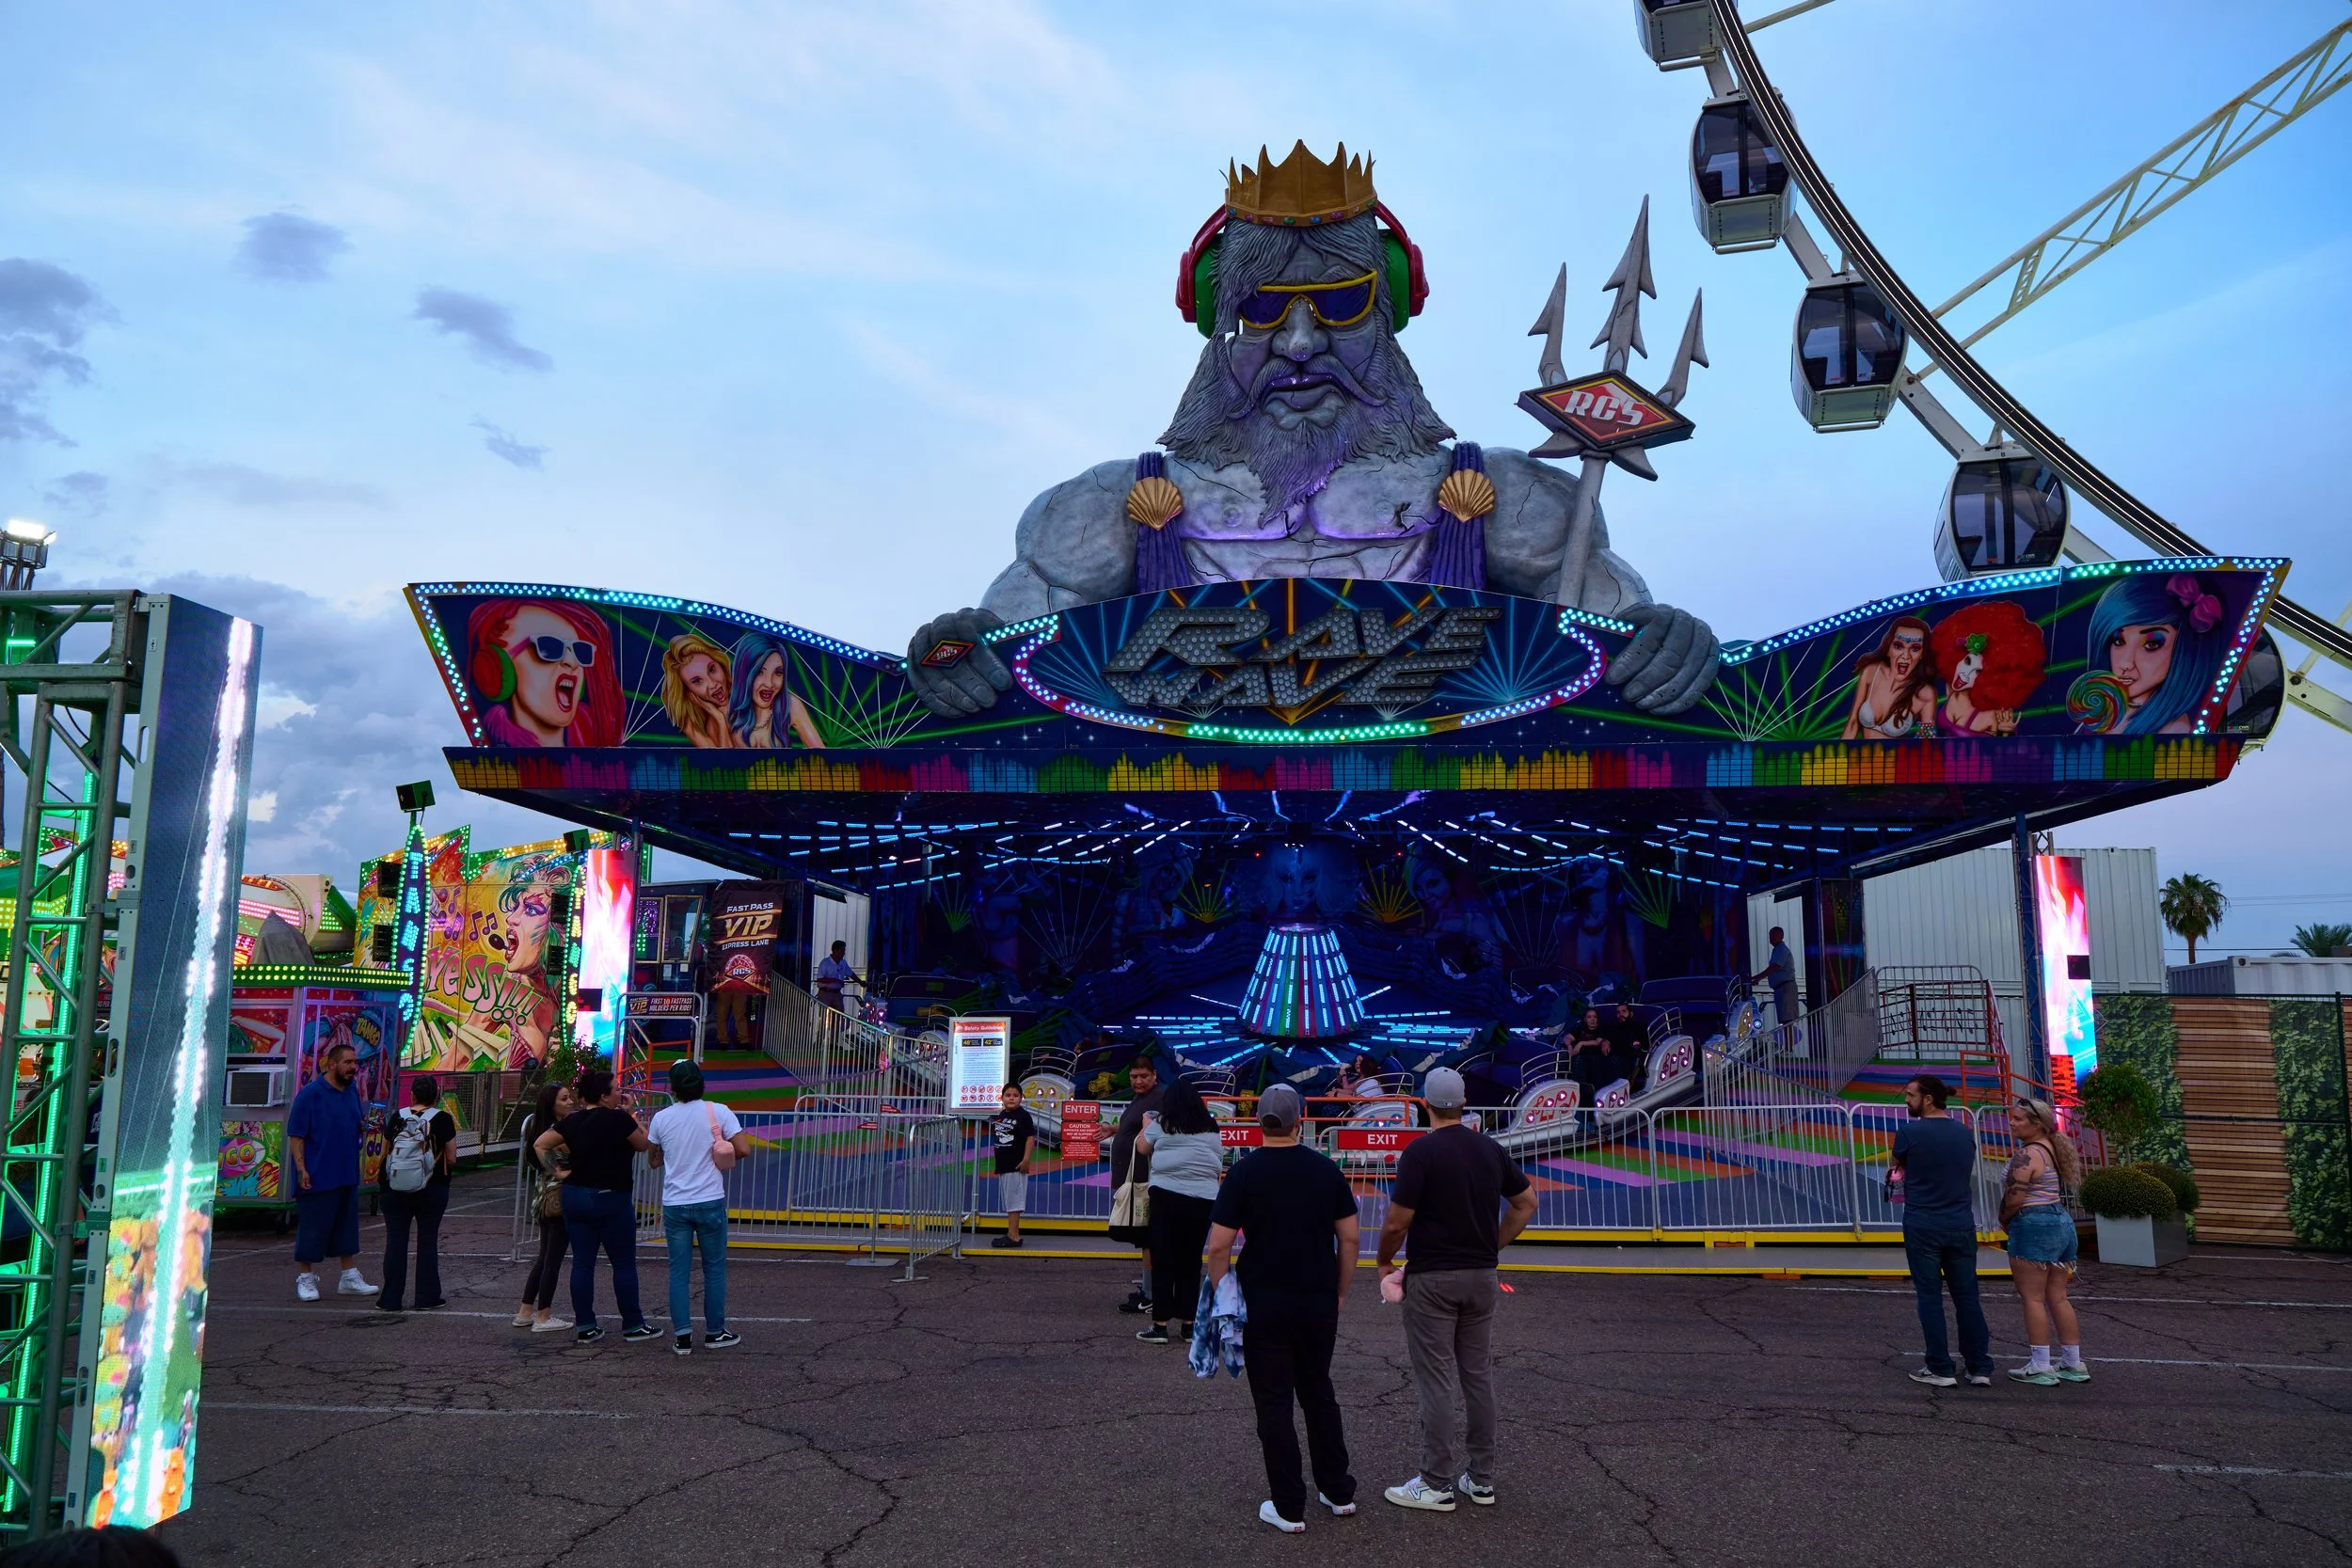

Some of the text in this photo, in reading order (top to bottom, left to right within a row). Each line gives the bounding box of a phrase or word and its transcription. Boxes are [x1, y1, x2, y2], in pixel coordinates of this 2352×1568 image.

[1564, 390, 1646, 426] RCS
[1103, 607, 1503, 672] RAVE
[1101, 652, 1484, 707] WAVE
[726, 902, 774, 913] FAST PASS
[724, 913, 773, 938] VIP
[750, 939, 770, 947] LANE
[629, 1001, 648, 1011] VIP
[355, 1017, 381, 1046] TANGO
[1065, 1104, 1097, 1114] ENTER
[1219, 1130, 1249, 1141] EXIT
[1367, 1133, 1398, 1145] EXIT
